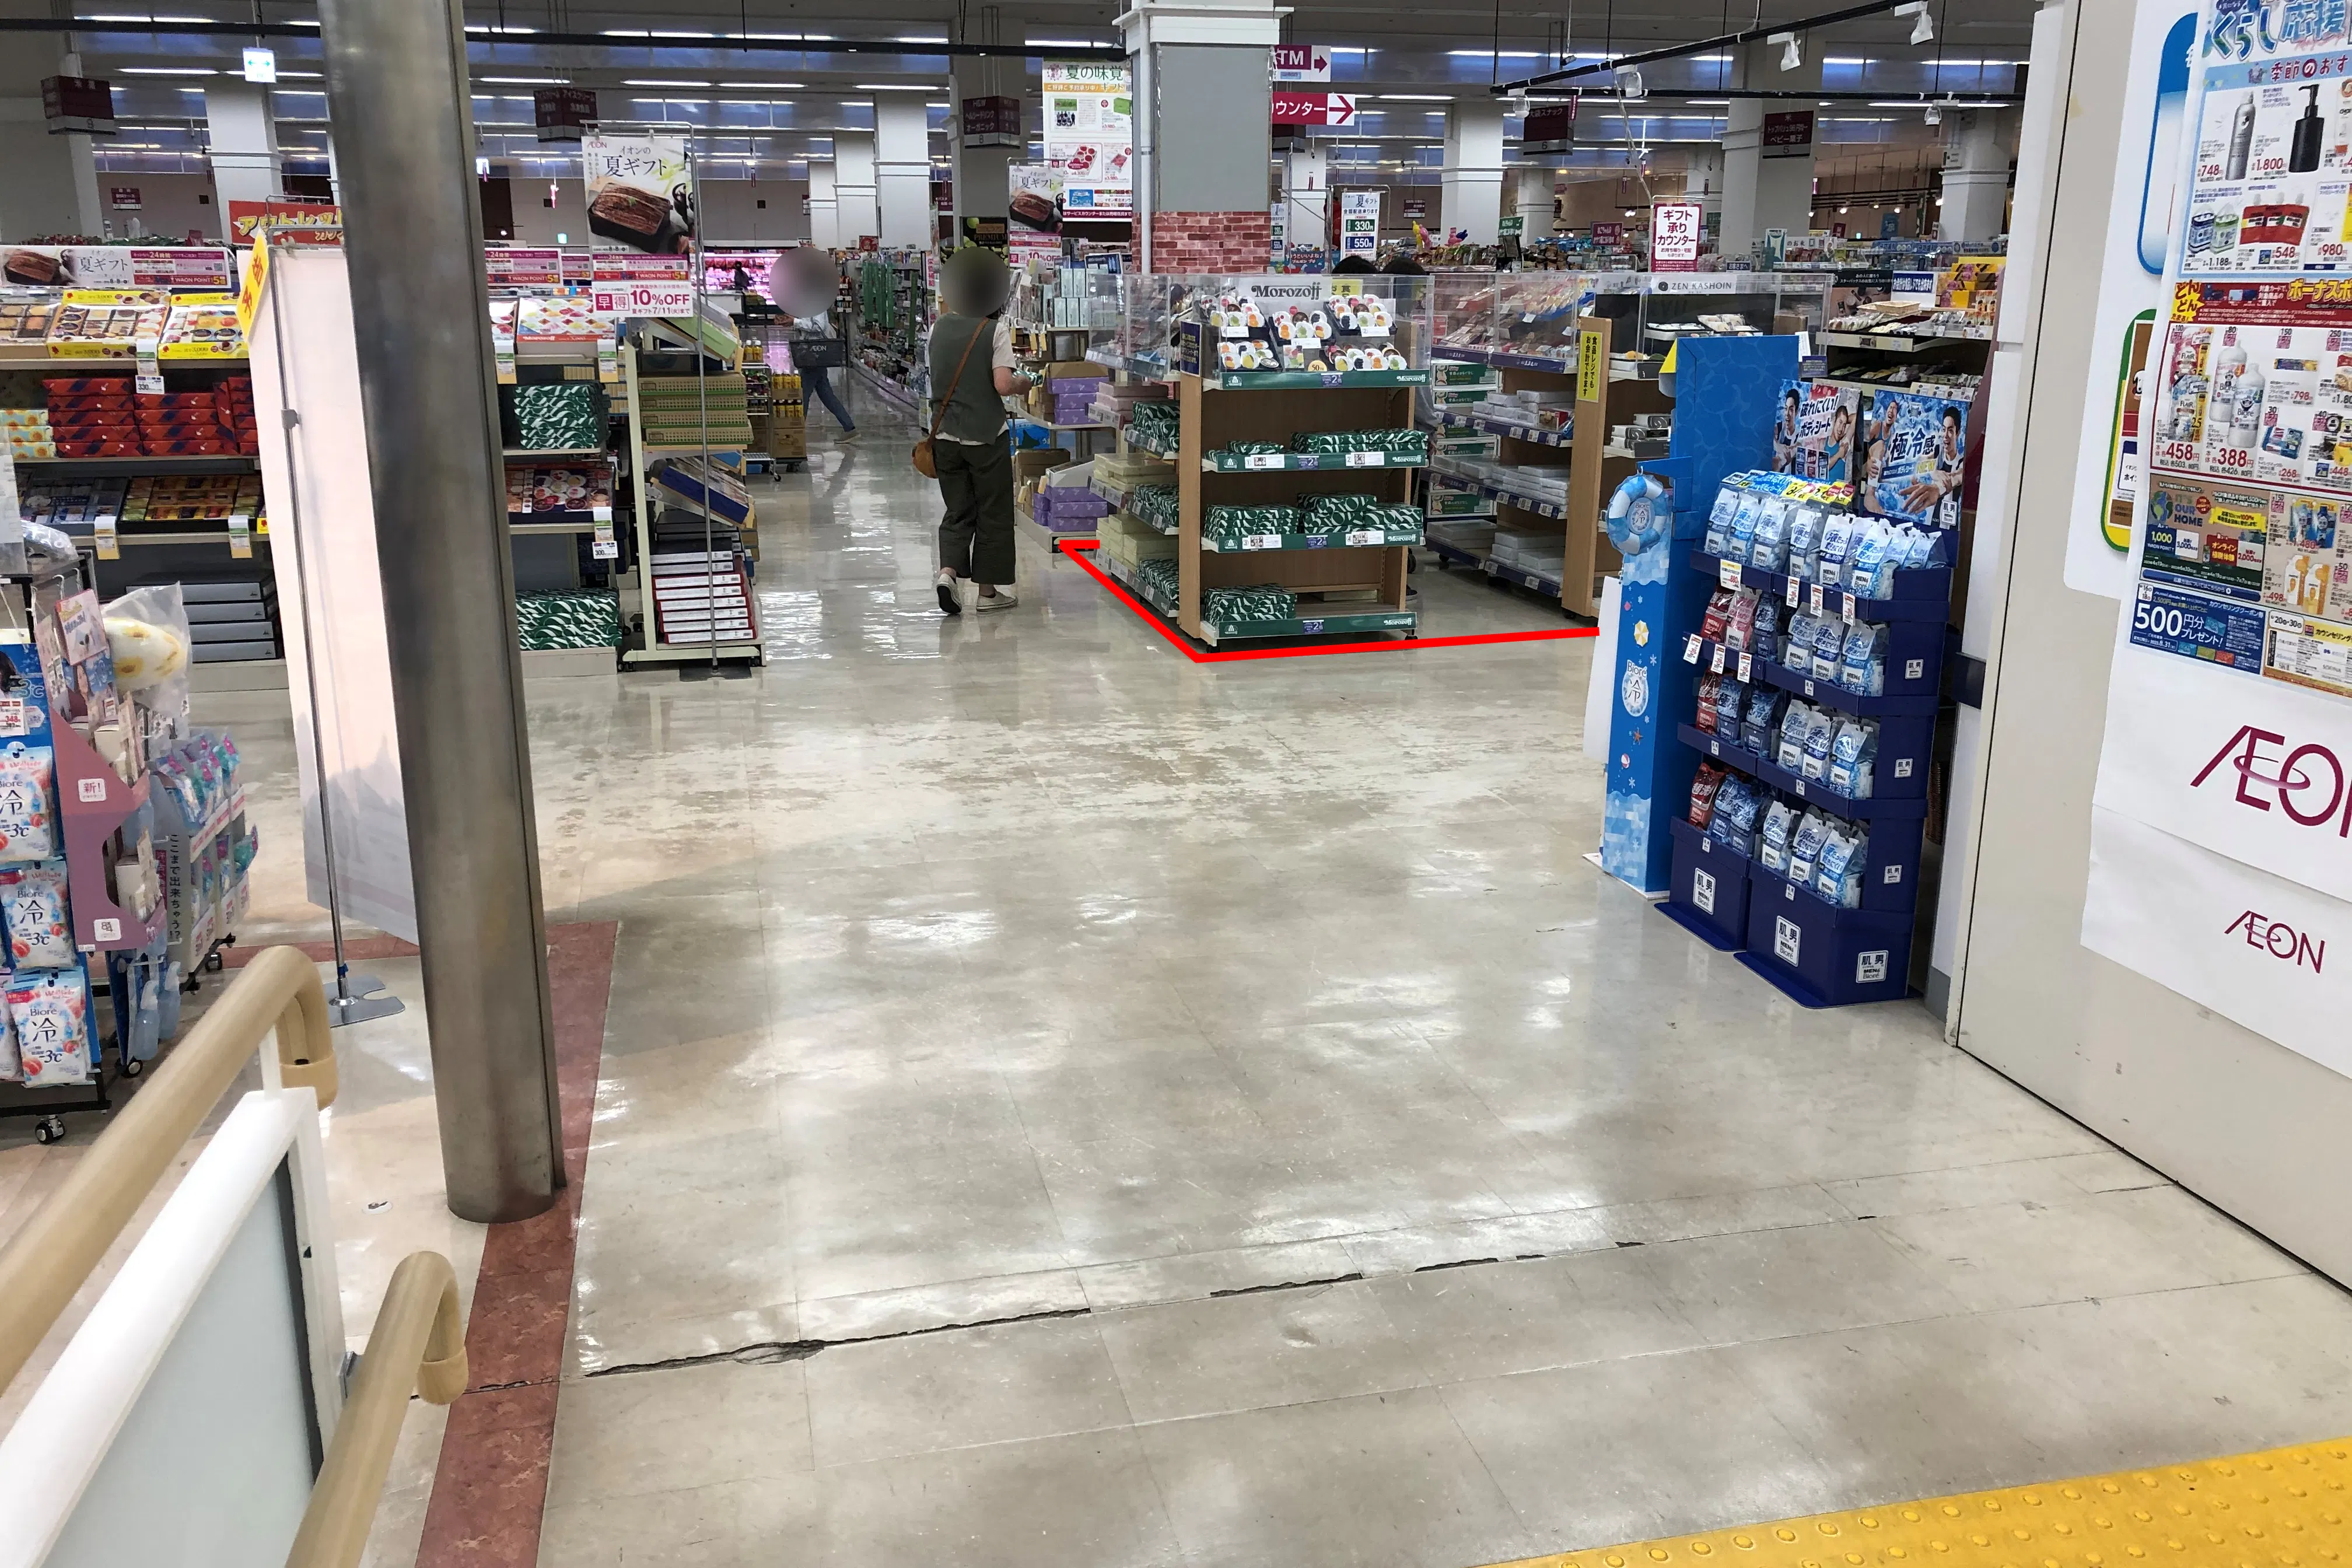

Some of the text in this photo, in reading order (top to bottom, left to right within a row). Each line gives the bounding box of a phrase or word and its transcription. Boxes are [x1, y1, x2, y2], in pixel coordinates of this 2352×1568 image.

[1275, 50, 1304, 65] TM
[1066, 65, 1124, 80] 夏の味覚
[1272, 100, 1326, 116] ウンター
[1542, 142, 1548, 150] 6
[603, 154, 667, 177] 夏ギフト
[1663, 209, 1693, 222] ギフト
[1667, 222, 1687, 234] 承り
[1657, 234, 1696, 246] カウンター
[630, 290, 690, 306] 10%OFF
[1251, 282, 1322, 300] Morozoff
[19, 900, 44, 925] 冷
[32, 1017, 58, 1043] 冷
